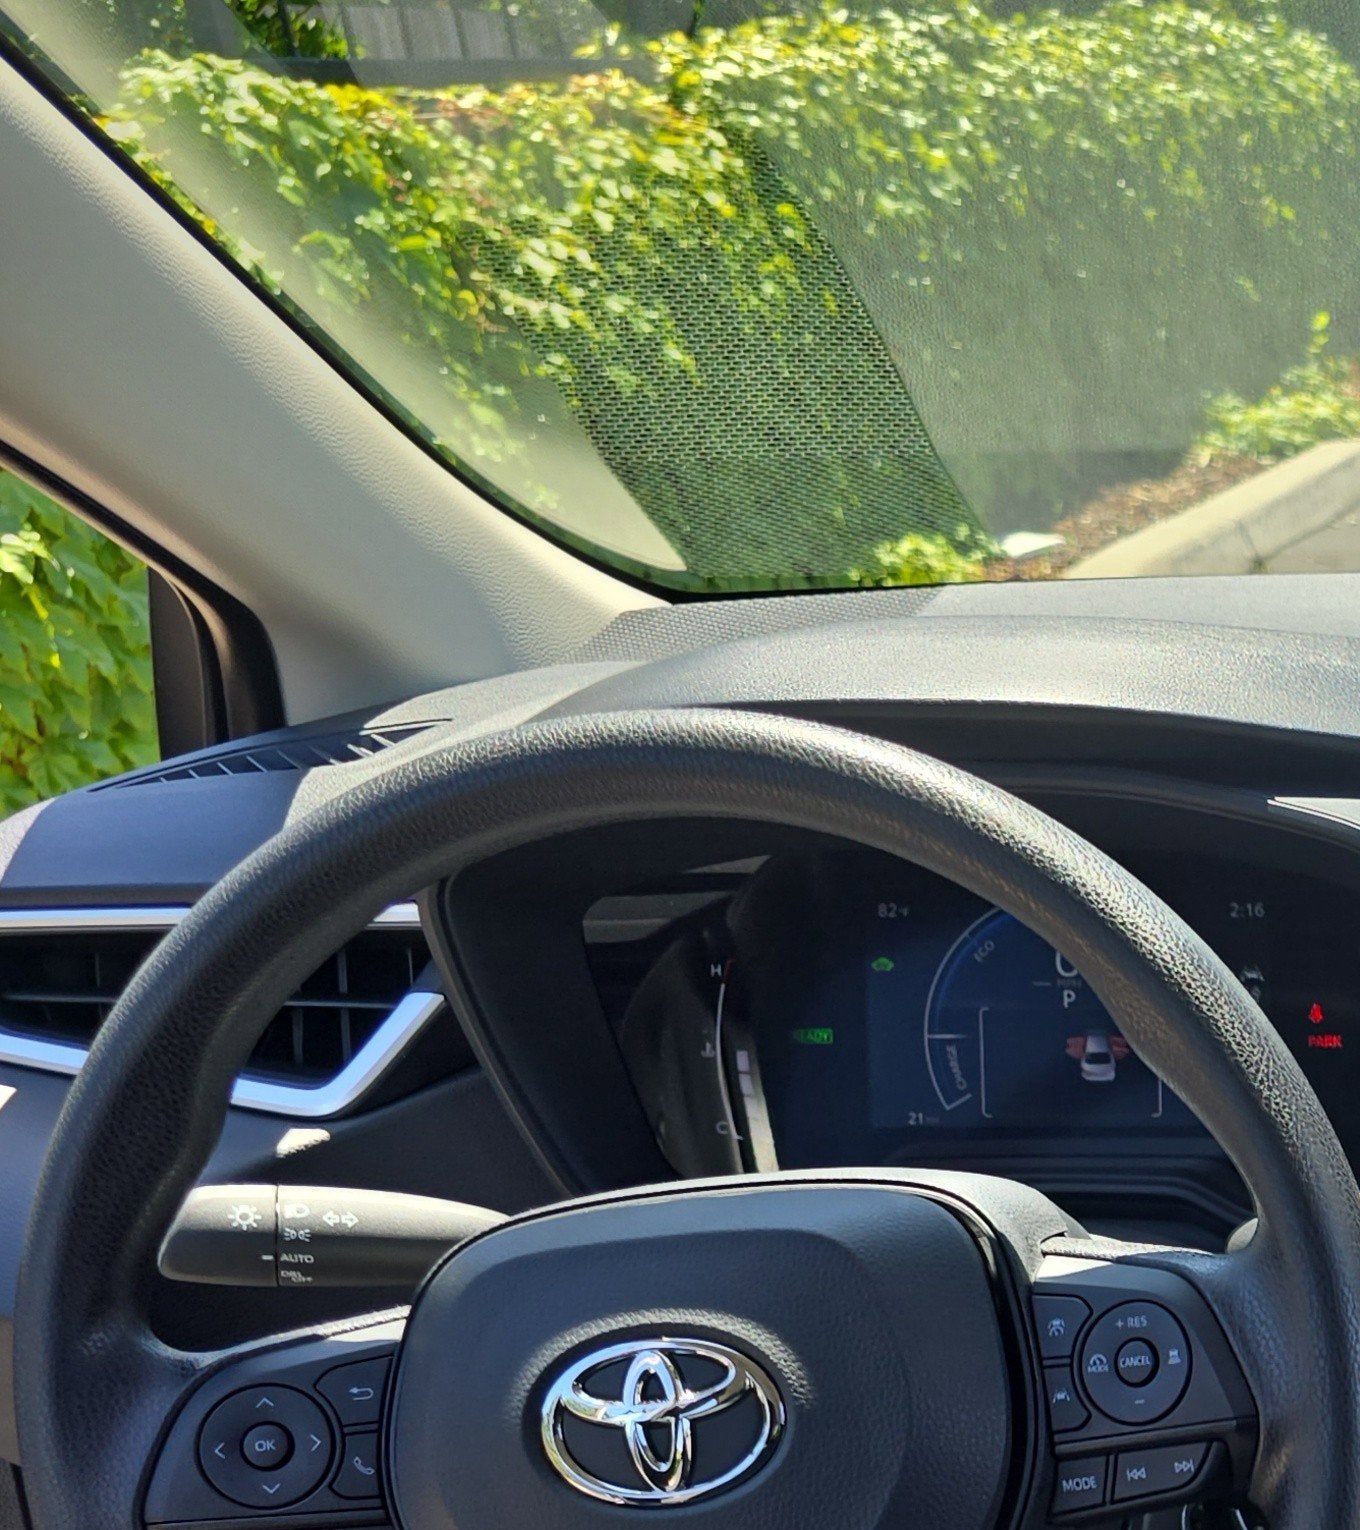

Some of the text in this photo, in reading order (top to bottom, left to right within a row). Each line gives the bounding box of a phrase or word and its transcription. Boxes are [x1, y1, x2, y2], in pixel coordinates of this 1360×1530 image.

[1229, 902, 1266, 918] 2:16
[1063, 989, 1076, 1008] P
[1307, 1034, 1343, 1048] PARK
[907, 1112, 924, 1125] 21
[280, 1252, 315, 1264] AUTO
[1127, 1315, 1149, 1328] RES
[1119, 1355, 1151, 1369] CANCEL
[255, 1440, 276, 1451] OK
[1062, 1476, 1098, 1492] MODE
